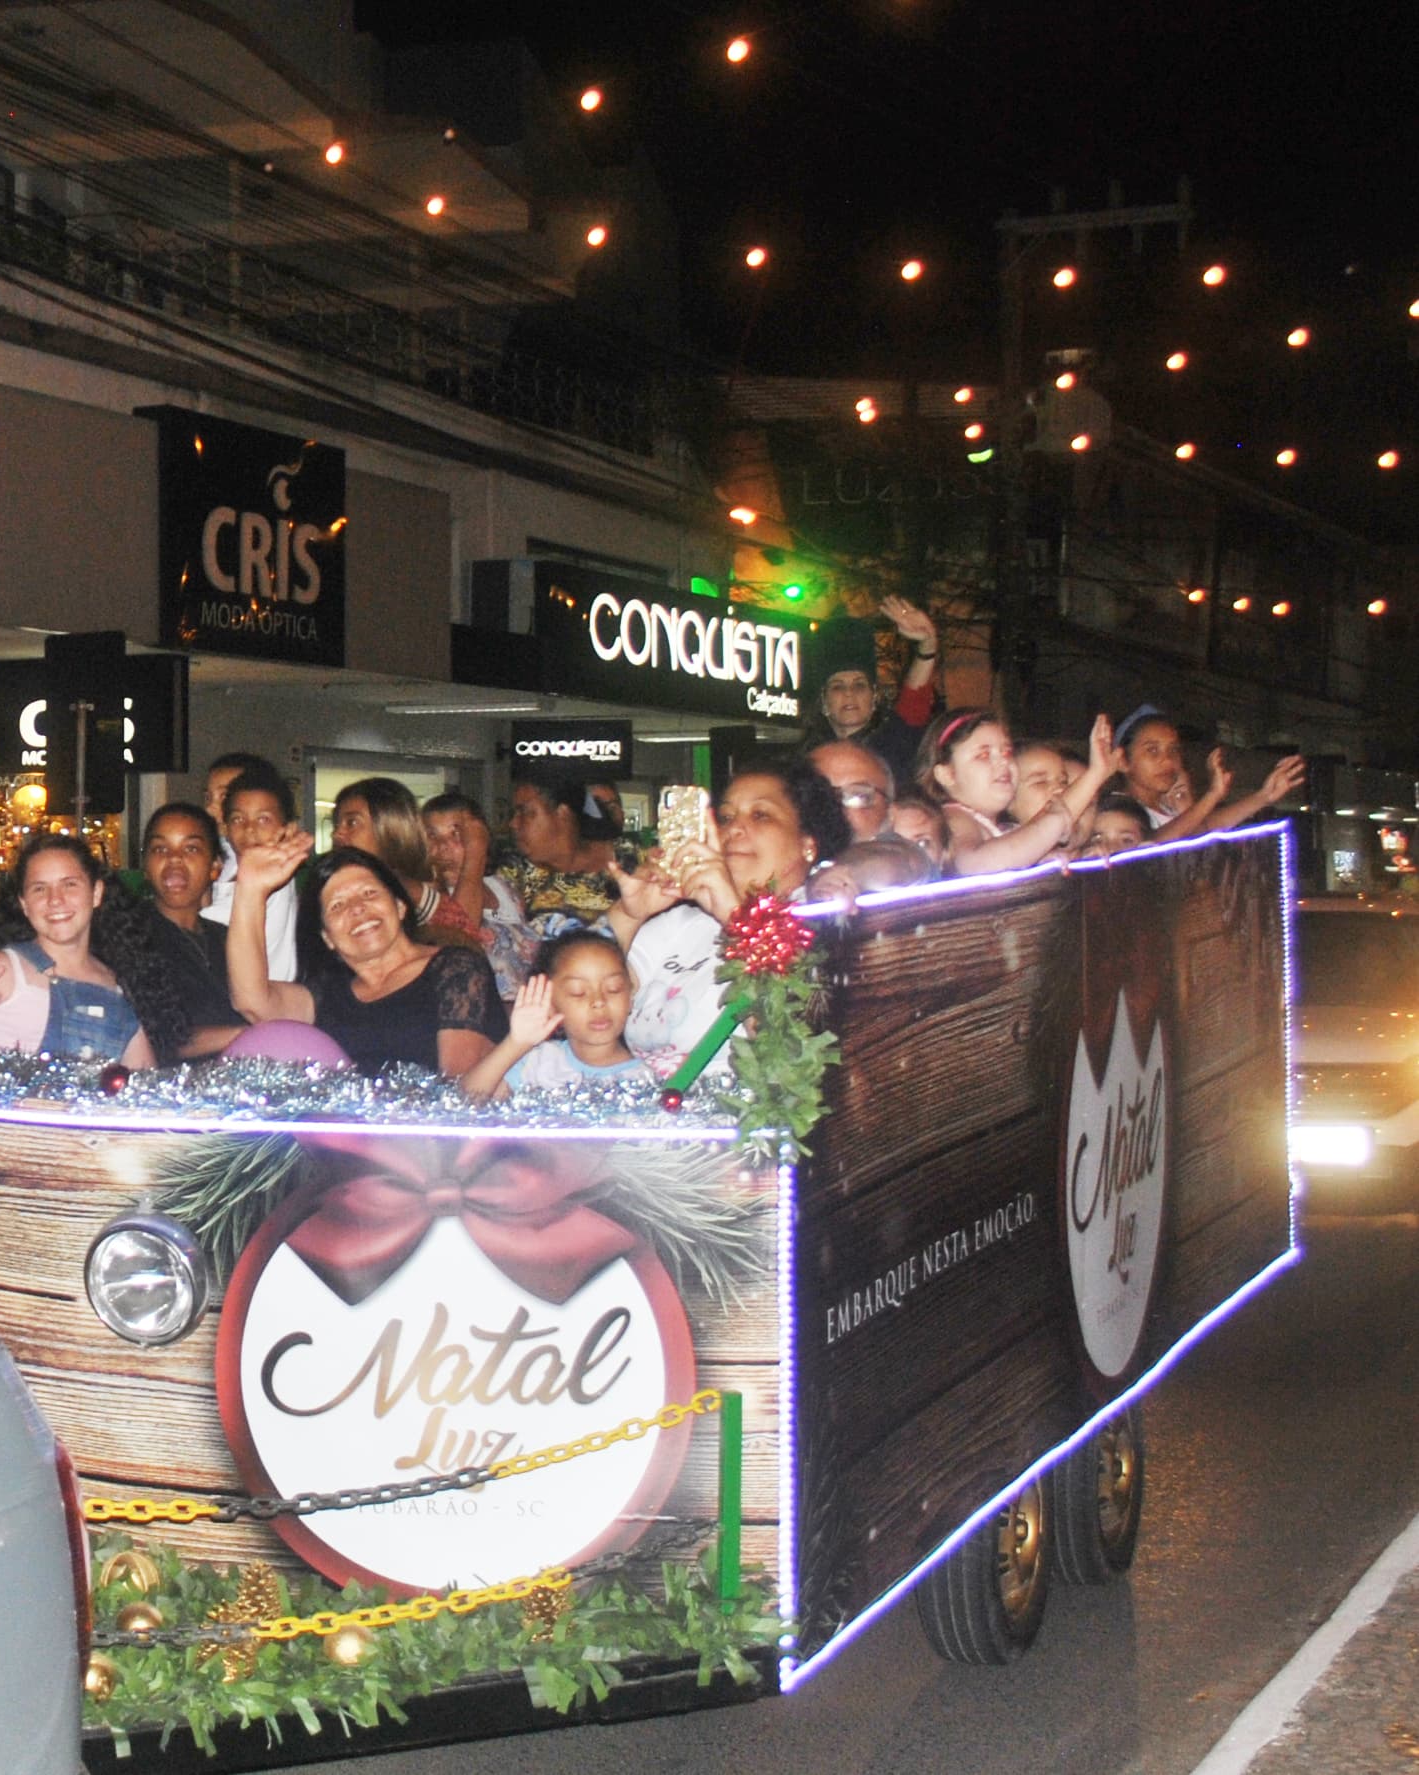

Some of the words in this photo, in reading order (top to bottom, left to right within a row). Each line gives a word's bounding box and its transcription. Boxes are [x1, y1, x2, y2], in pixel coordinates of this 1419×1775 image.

[202, 505, 321, 605] CRIS
[201, 601, 256, 631] MODA
[589, 593, 800, 690] CONQUISTA
[1071, 1068, 1162, 1234] Natal
[827, 1256, 916, 1345] EMBARQUE
[923, 1228, 969, 1281] NESTA
[261, 1302, 632, 1419] Natal
[393, 1406, 524, 1494] Luz
[516, 1500, 545, 1518] SC
